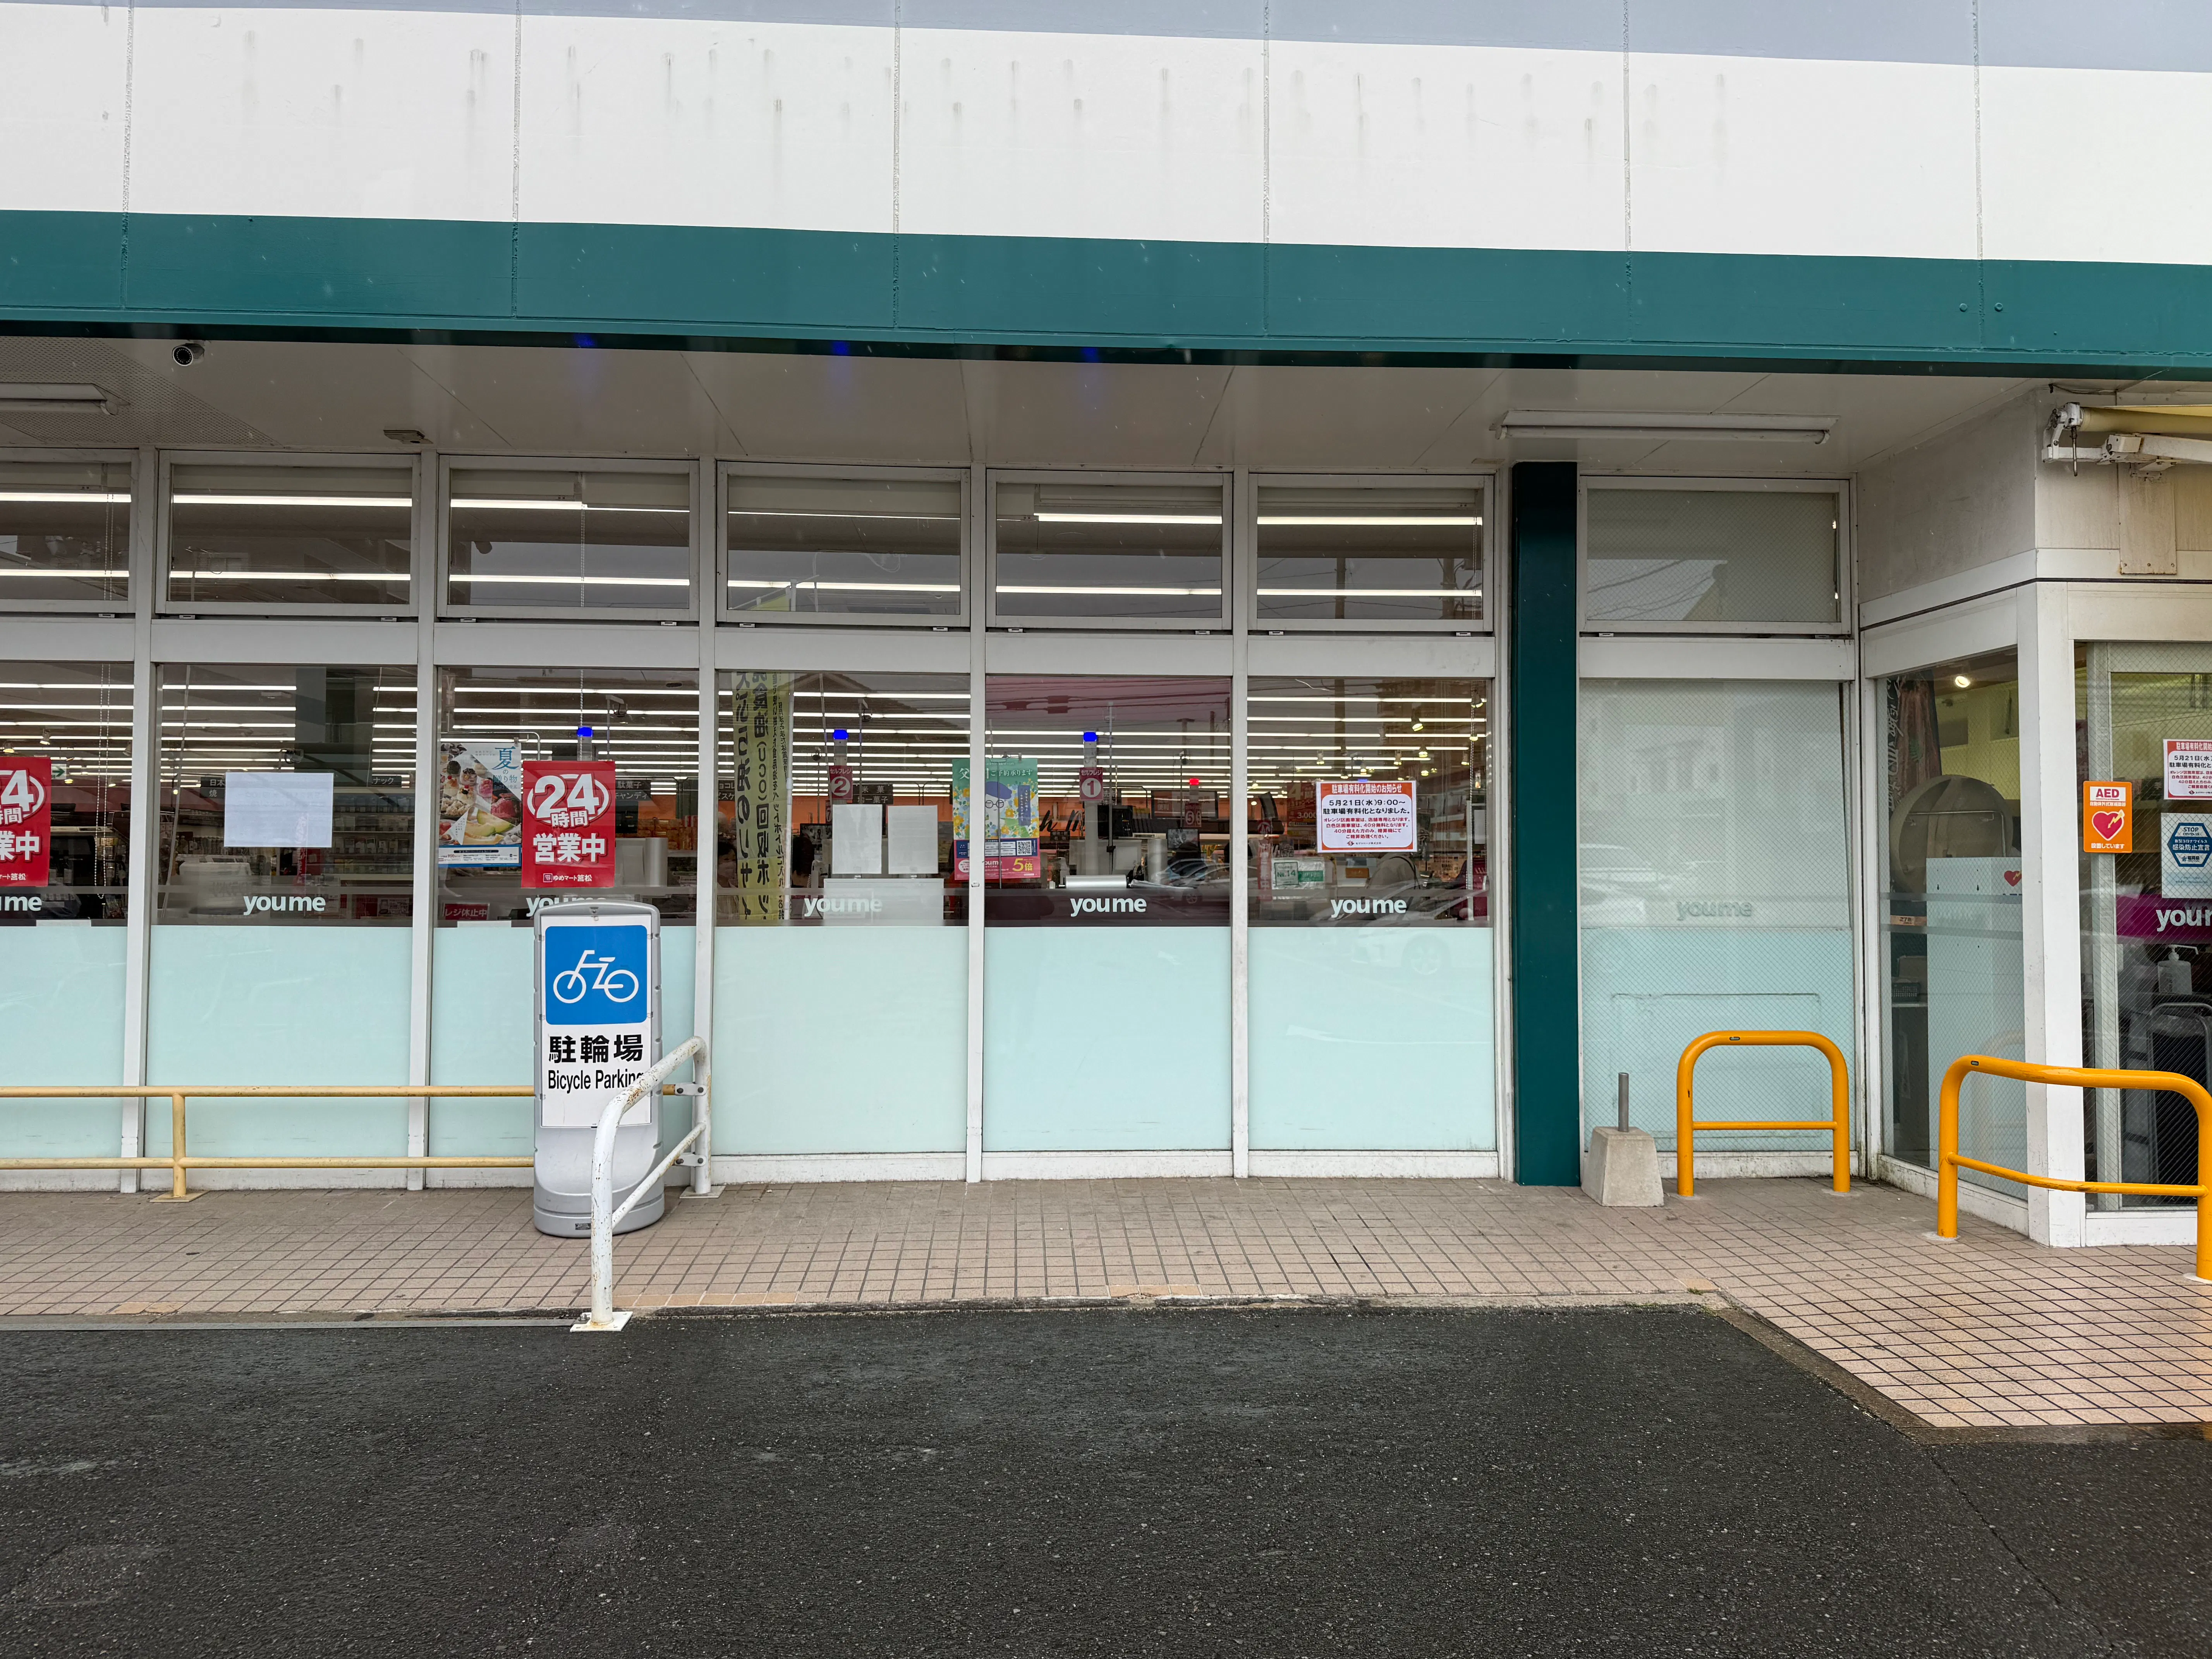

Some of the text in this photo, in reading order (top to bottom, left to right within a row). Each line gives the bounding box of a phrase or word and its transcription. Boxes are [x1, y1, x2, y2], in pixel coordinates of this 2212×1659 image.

[492, 746, 519, 769] 夏
[834, 778, 847, 793] 2
[1087, 780, 1094, 795] 1
[1332, 783, 1402, 794] 駐車場有料化開始のお知らせ
[2096, 788, 2119, 798] AED
[535, 774, 599, 818] 24
[551, 810, 588, 828] 時間
[533, 833, 605, 862] 営業中
[446, 908, 488, 917] レジ休止中
[549, 1034, 643, 1063] 駐輪場
[548, 1070, 591, 1094] Bicycle
